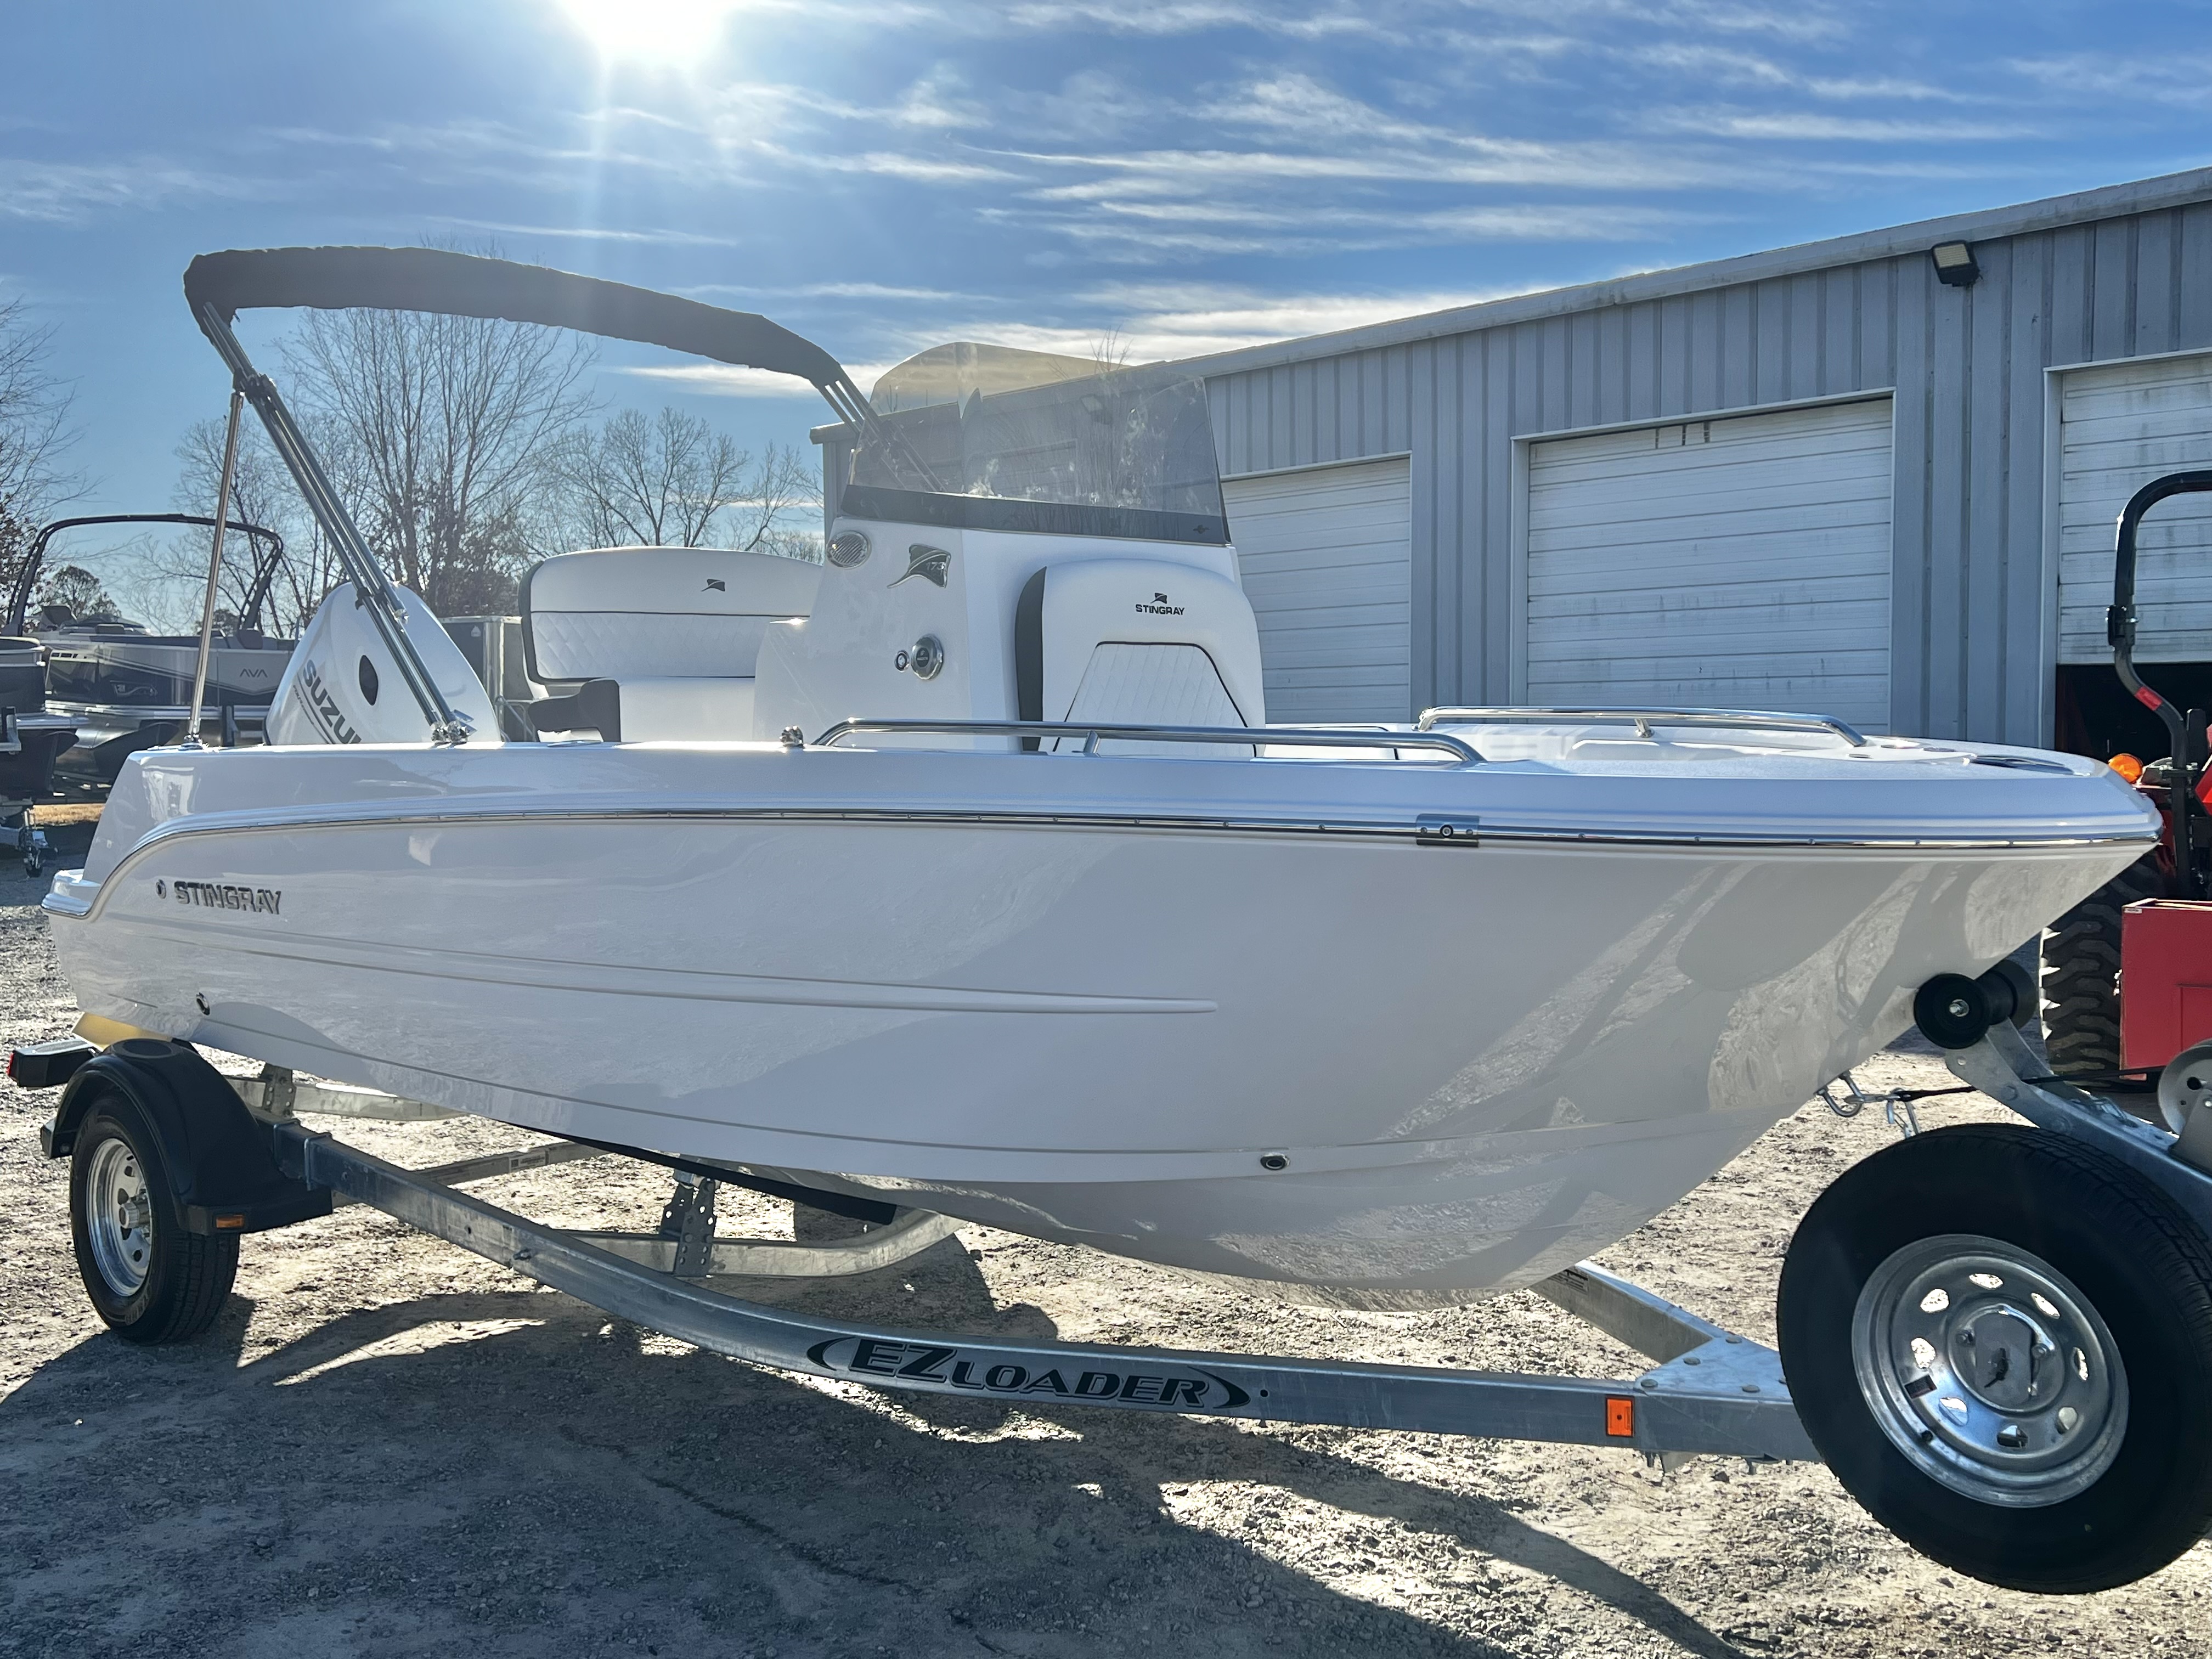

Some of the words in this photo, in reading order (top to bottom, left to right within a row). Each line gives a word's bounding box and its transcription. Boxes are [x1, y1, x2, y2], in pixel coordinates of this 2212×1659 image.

[1135, 603, 1185, 616] STINGRAY
[303, 659, 362, 744] SUZU
[174, 881, 281, 915] STINGRAY
